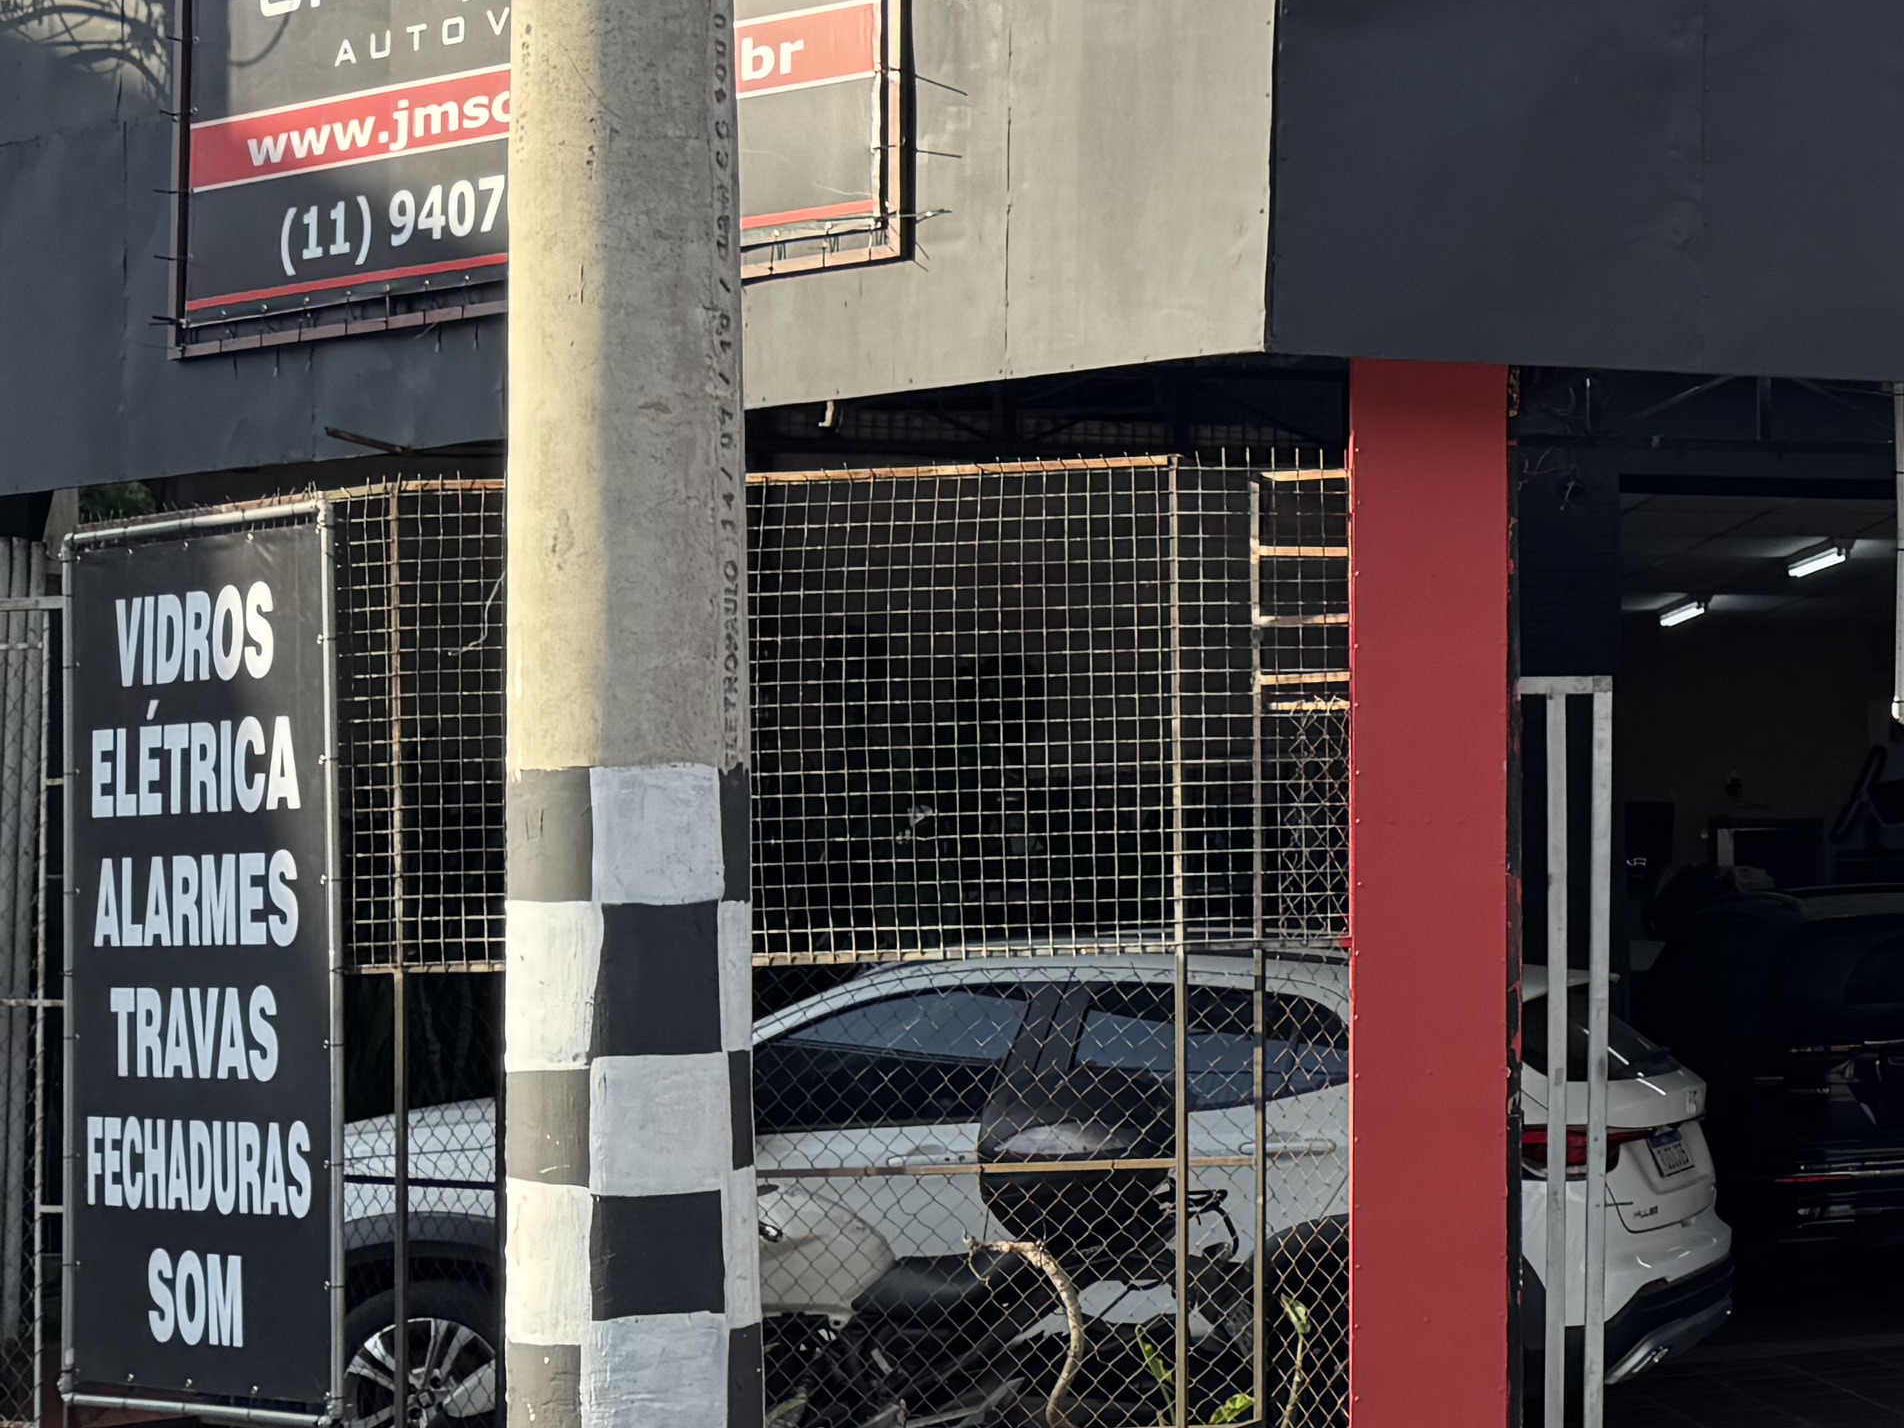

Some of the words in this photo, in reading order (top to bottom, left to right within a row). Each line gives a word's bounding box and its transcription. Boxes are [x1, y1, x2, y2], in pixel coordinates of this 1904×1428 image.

[335, 17, 467, 67] AUTO
[281, 196, 371, 275] (11)
[116, 581, 274, 686] VIDROS
[92, 700, 301, 818] ELÉTRICA
[94, 849, 298, 946] ALARMES
[111, 985, 278, 1082] TRAVAS
[87, 1116, 311, 1218] FECHADURAS
[148, 1248, 243, 1347] SOM
